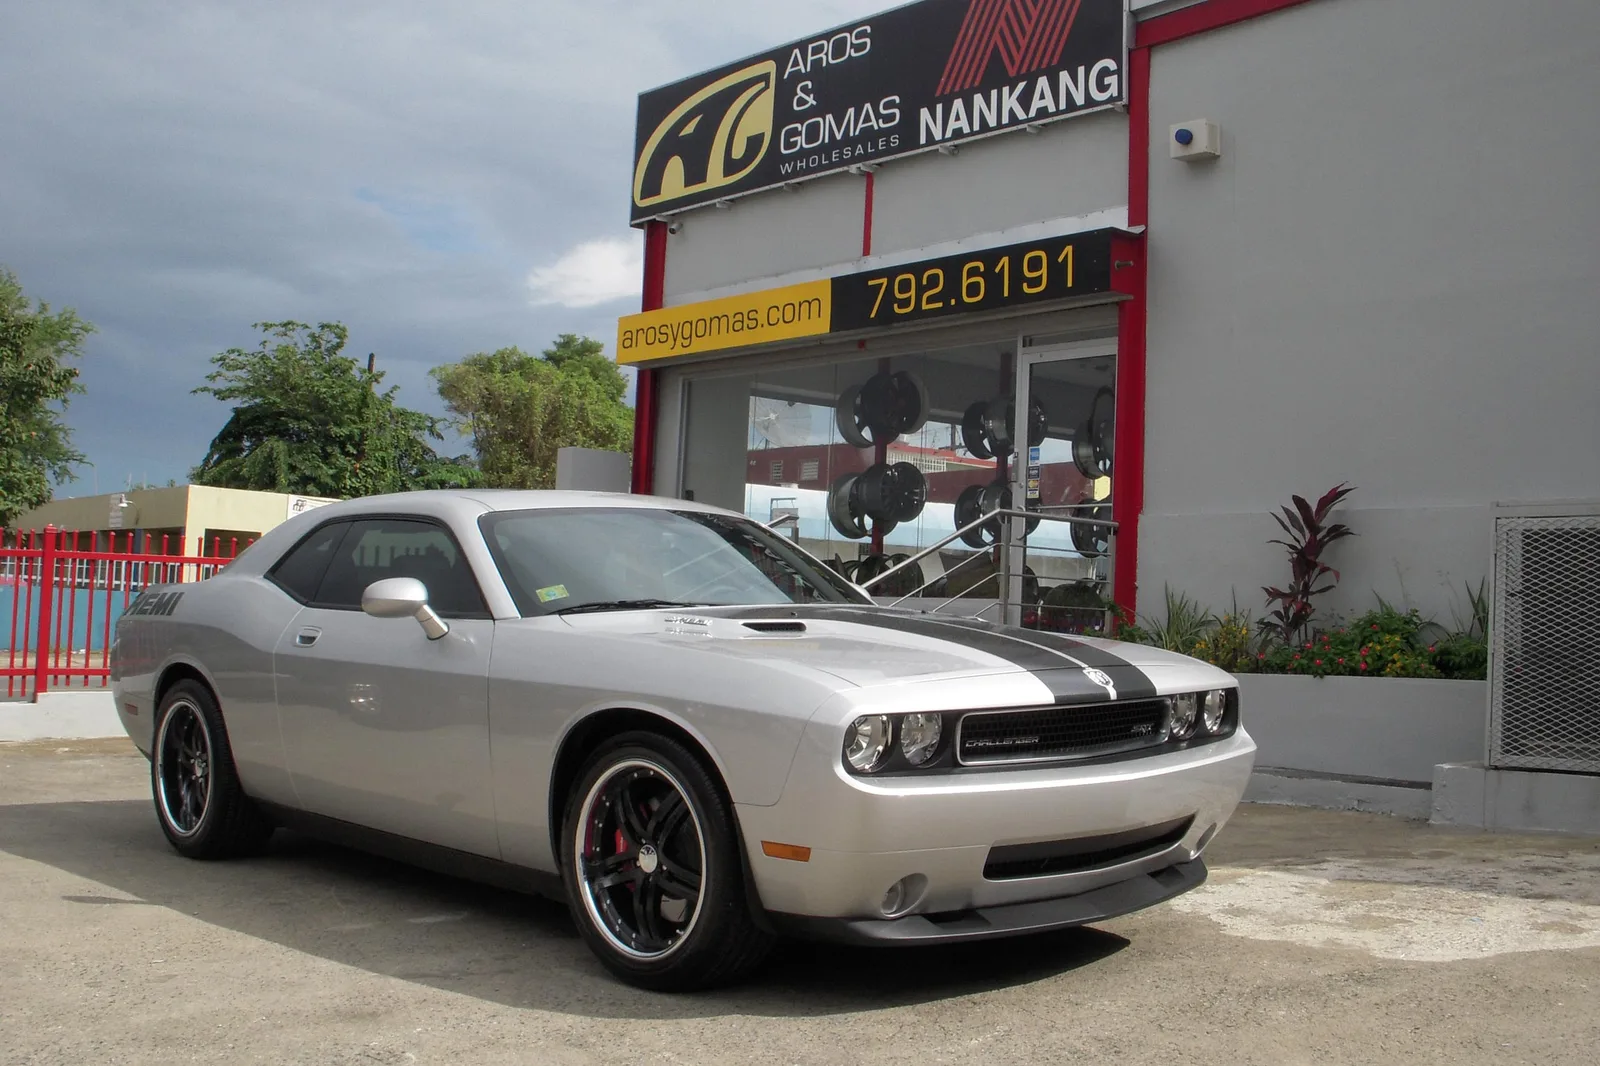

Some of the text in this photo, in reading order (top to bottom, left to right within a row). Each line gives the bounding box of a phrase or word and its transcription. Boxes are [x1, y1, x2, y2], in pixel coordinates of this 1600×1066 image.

[783, 25, 872, 79] AROS
[793, 80, 817, 111] &
[919, 58, 1119, 145] NANKANG
[780, 95, 900, 155] GOMAS
[780, 134, 899, 175] WHOLESALES
[867, 244, 1074, 319] 792.6191
[621, 295, 822, 350] arosygomas.com
